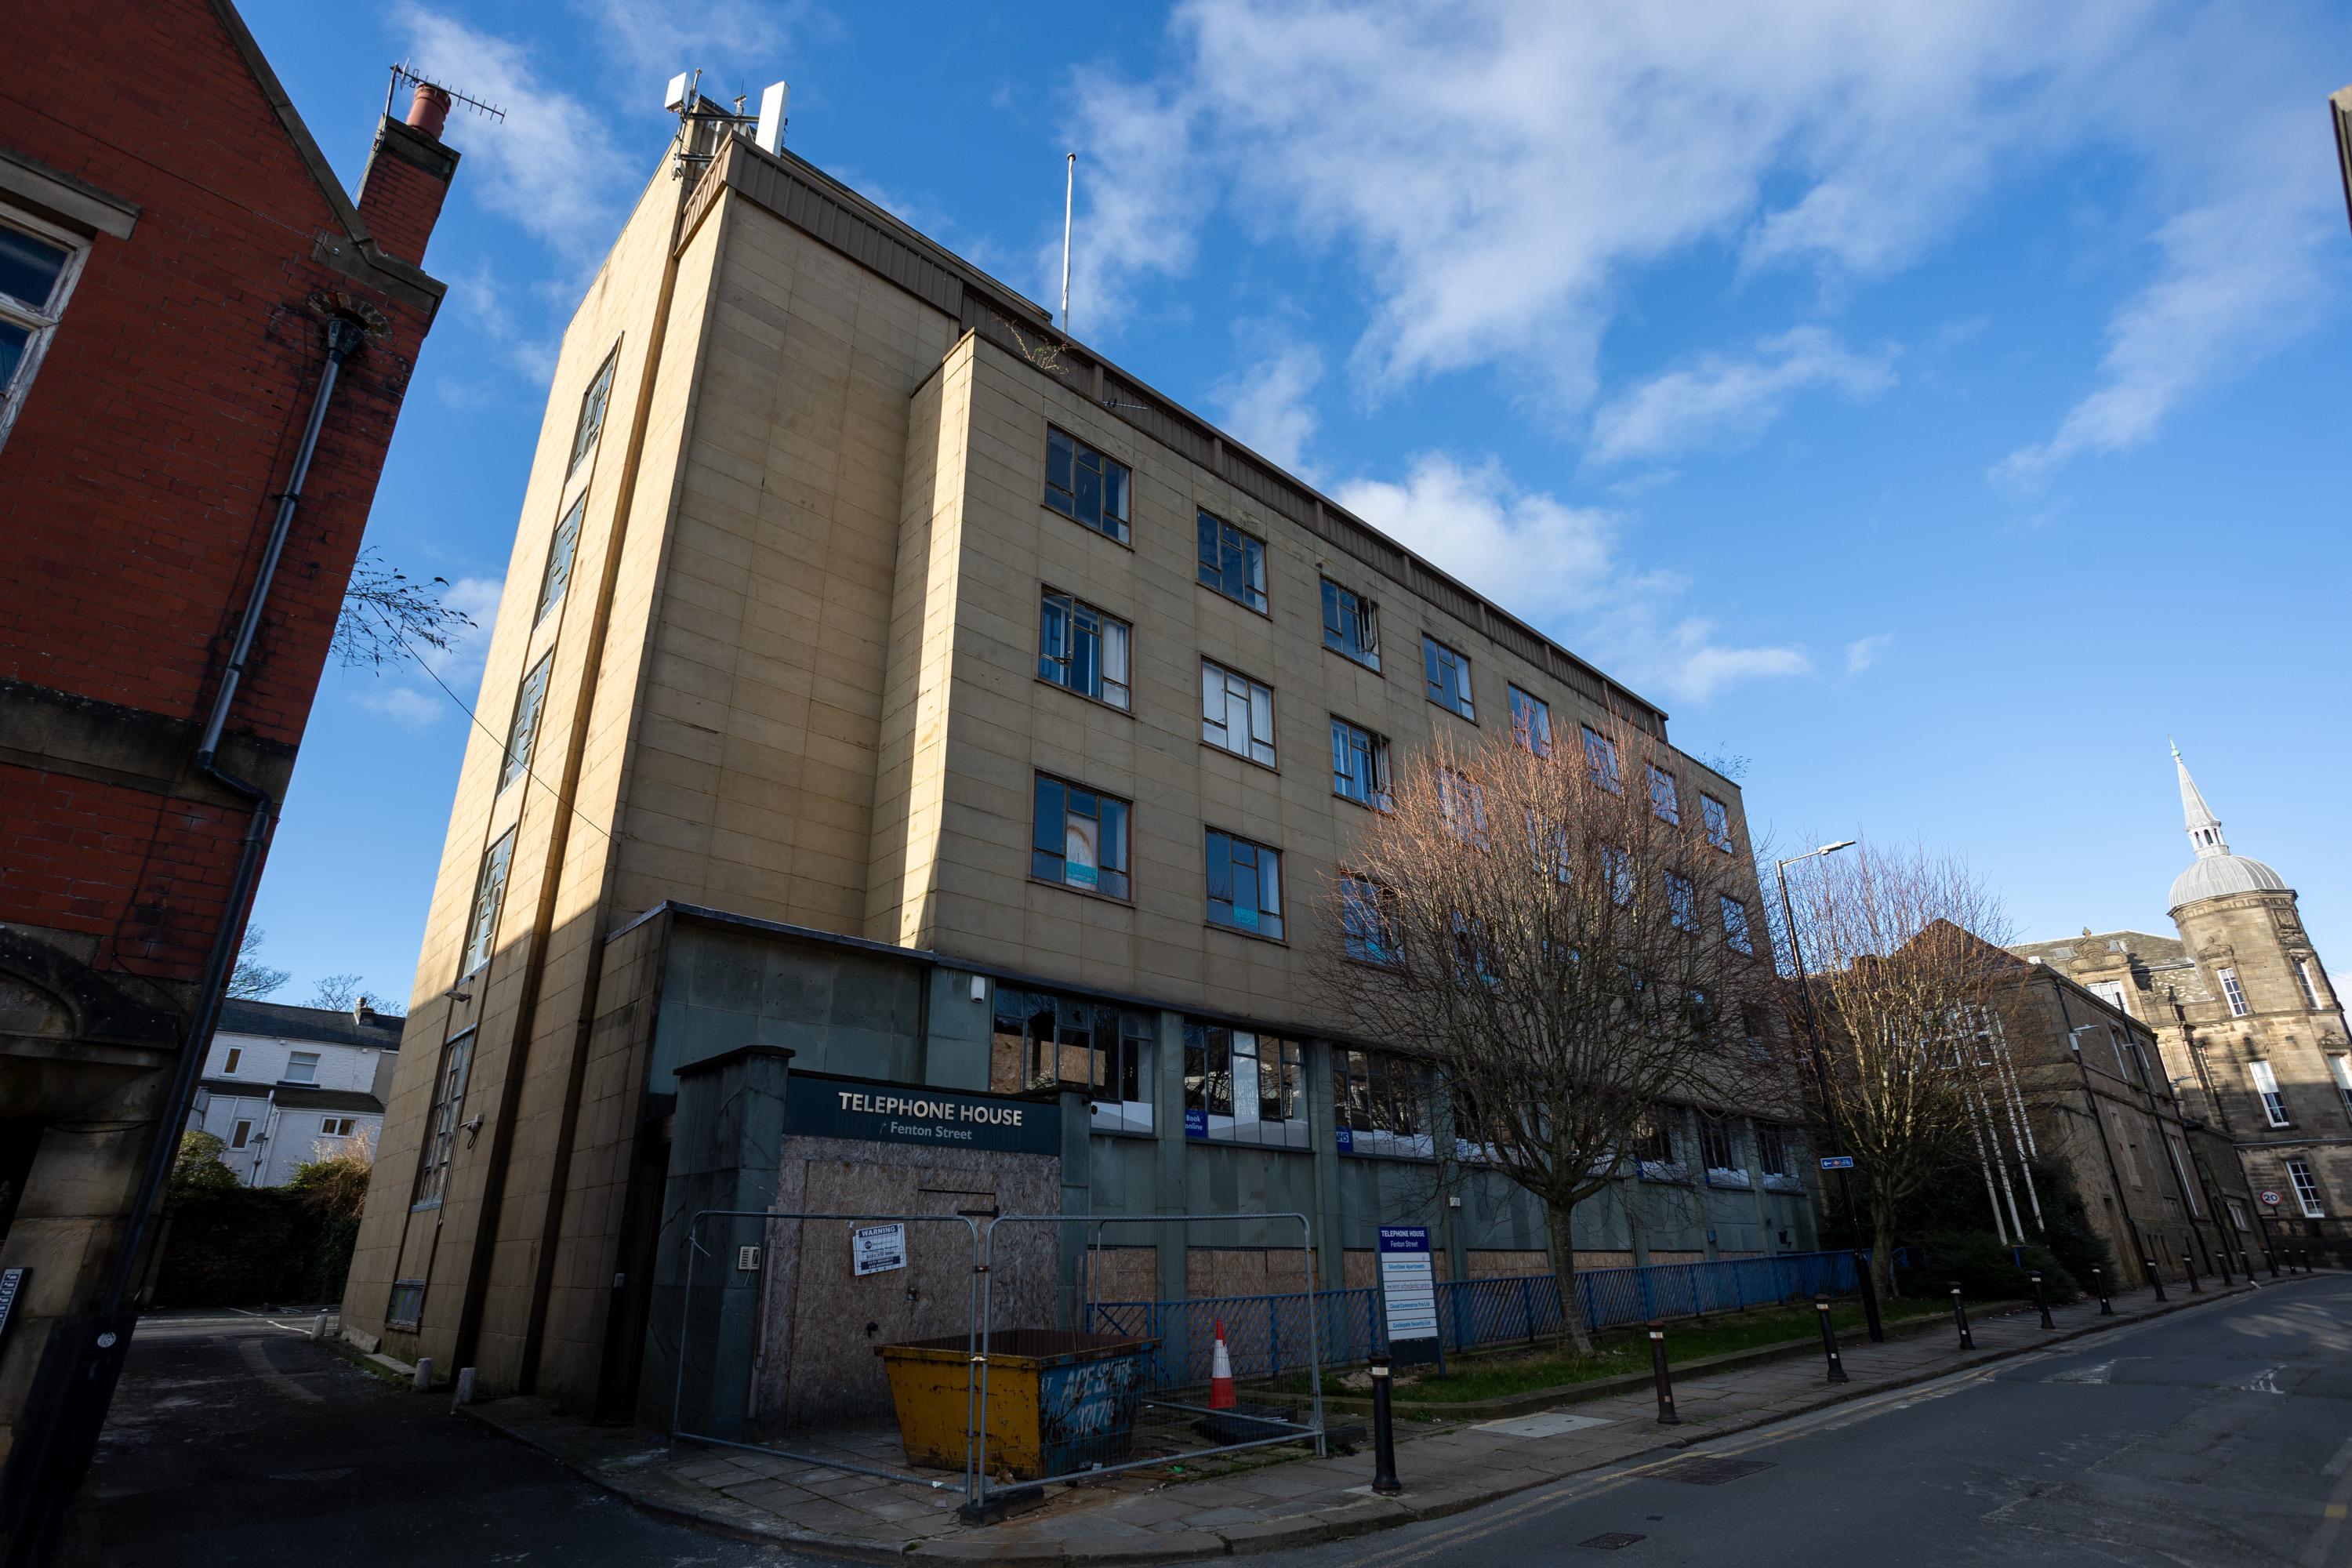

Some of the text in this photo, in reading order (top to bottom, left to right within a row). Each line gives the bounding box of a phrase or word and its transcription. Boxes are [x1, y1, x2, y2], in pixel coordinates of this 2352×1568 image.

[838, 1091, 1022, 1127] TELEPHONE HOUSE
[890, 1121, 972, 1140] Fenton Street
[1185, 1122, 1203, 1131] online
[861, 1226, 895, 1236] WARNING
